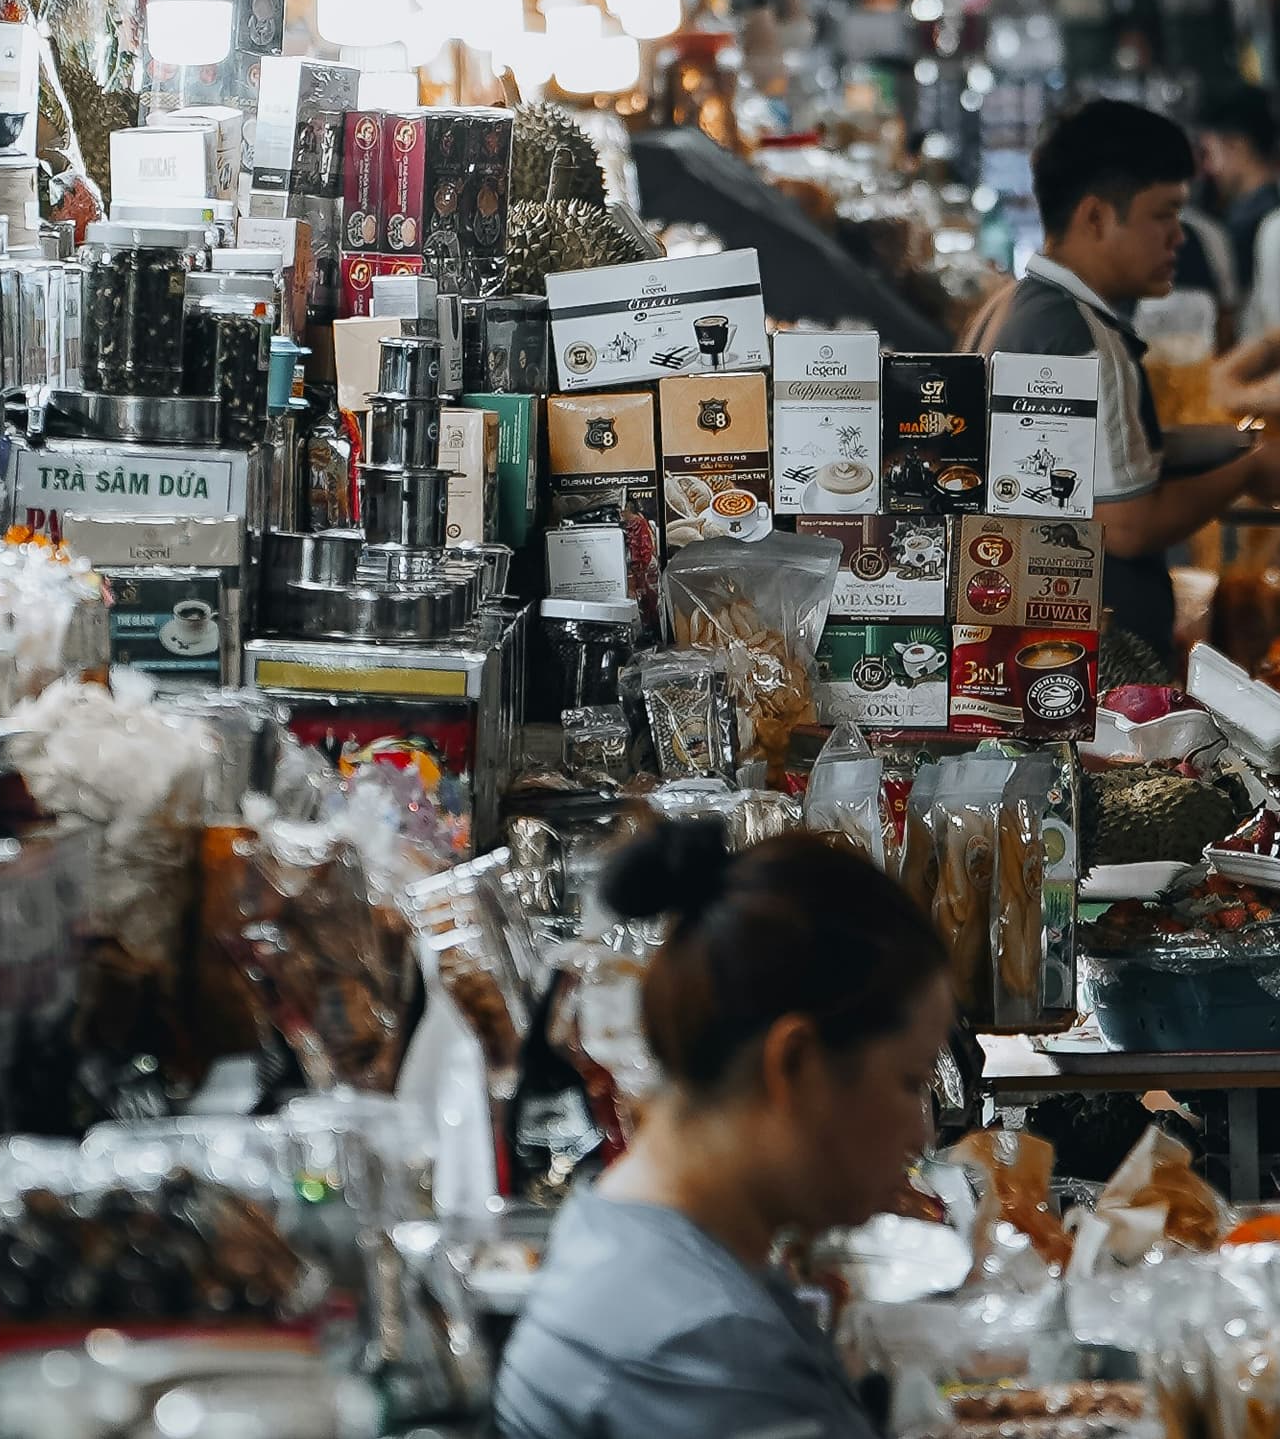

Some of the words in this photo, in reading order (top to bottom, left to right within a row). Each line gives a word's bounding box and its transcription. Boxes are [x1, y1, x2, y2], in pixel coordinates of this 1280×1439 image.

[806, 364, 847, 377] Legend
[788, 382, 861, 400] Cappuccino
[920, 381, 944, 395] G7
[1027, 383, 1064, 395] Legend
[703, 410, 726, 427] G8
[588, 429, 613, 446] G8
[38, 464, 87, 492] TRÀ
[95, 466, 149, 495] SÂM
[561, 478, 593, 487] DURIAN
[594, 475, 649, 485] CAPPUCCINO
[129, 547, 171, 560] Legend
[1038, 577, 1053, 596] 3
[1072, 578, 1081, 596] 1
[834, 594, 907, 606] WEASEL
[1028, 604, 1089, 621] LUWAK
[1030, 674, 1080, 699] HIGHLANDS
[1039, 703, 1078, 717] COFFEE
